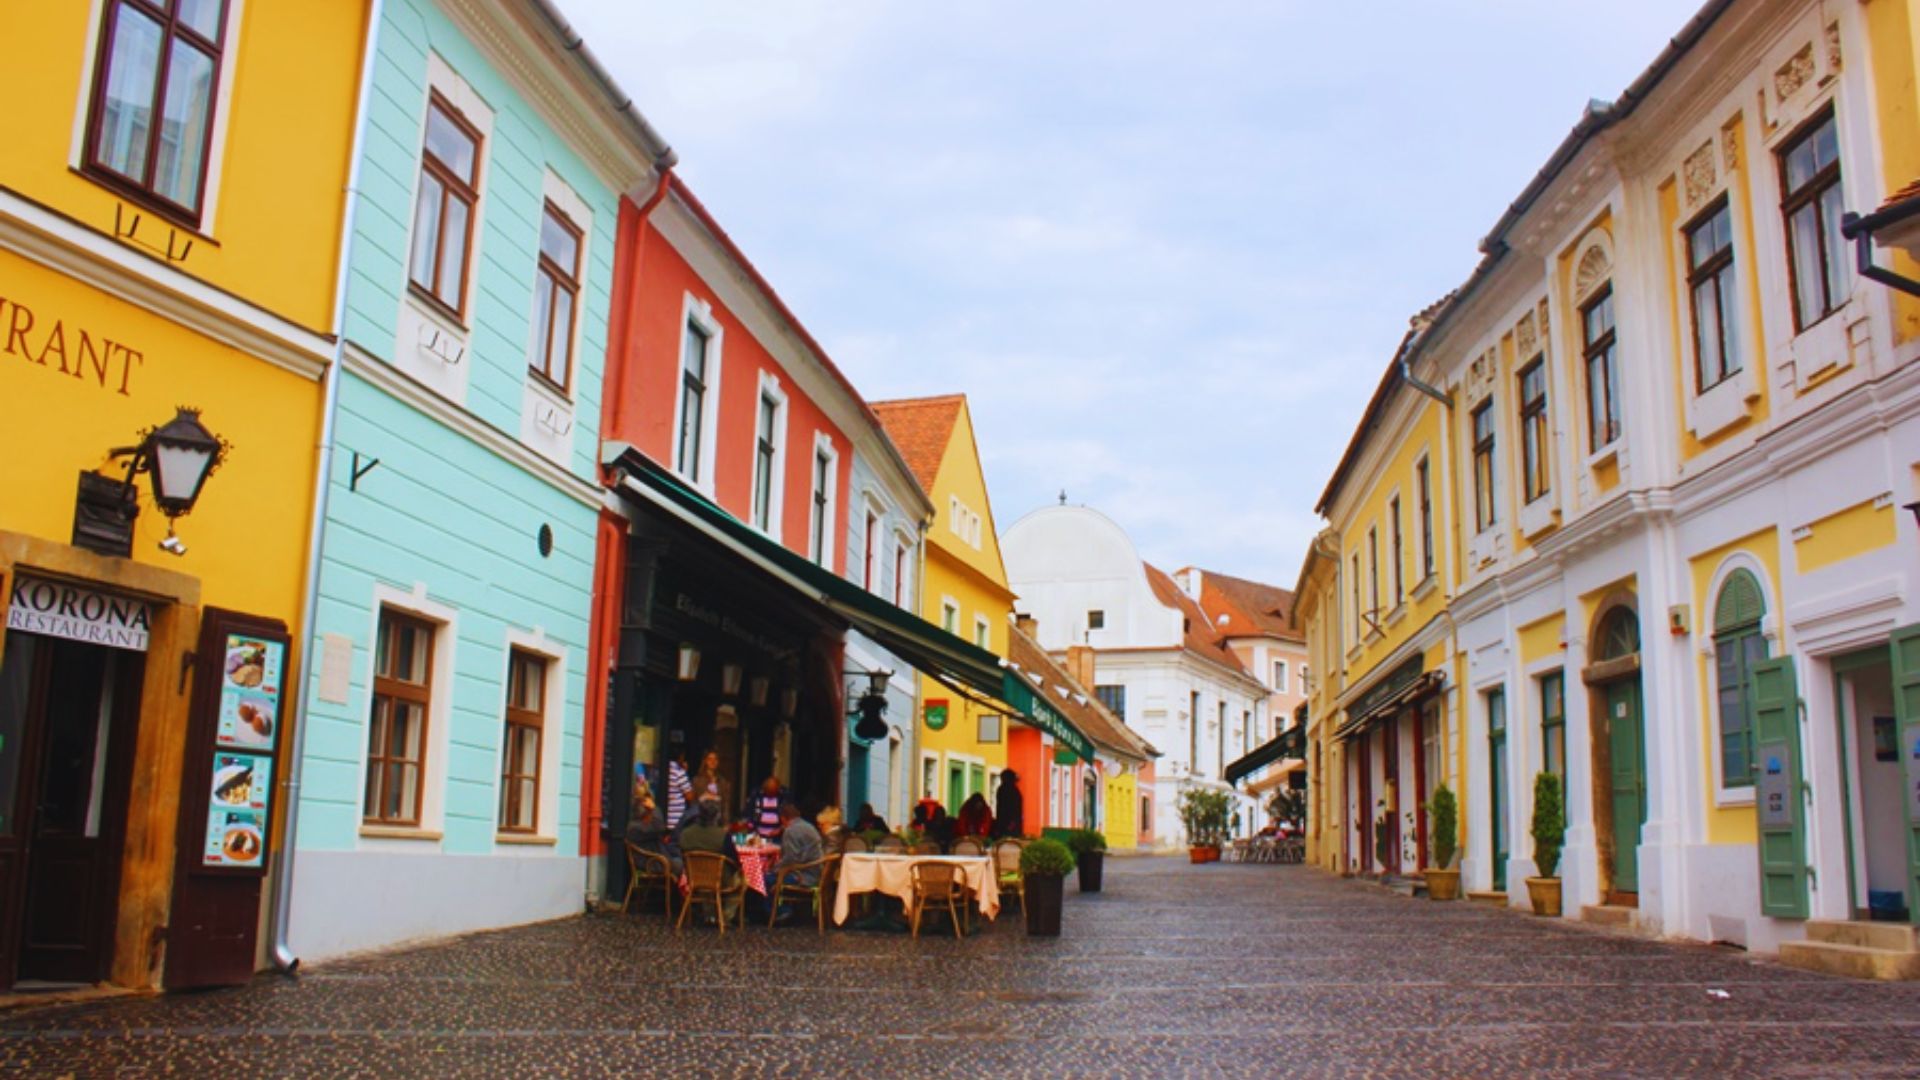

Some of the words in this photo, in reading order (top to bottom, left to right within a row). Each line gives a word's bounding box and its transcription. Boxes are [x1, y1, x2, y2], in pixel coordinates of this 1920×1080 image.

[0, 297, 143, 395] RANT
[10, 609, 147, 648] RESTAURANT
[11, 578, 149, 630] KORONA
